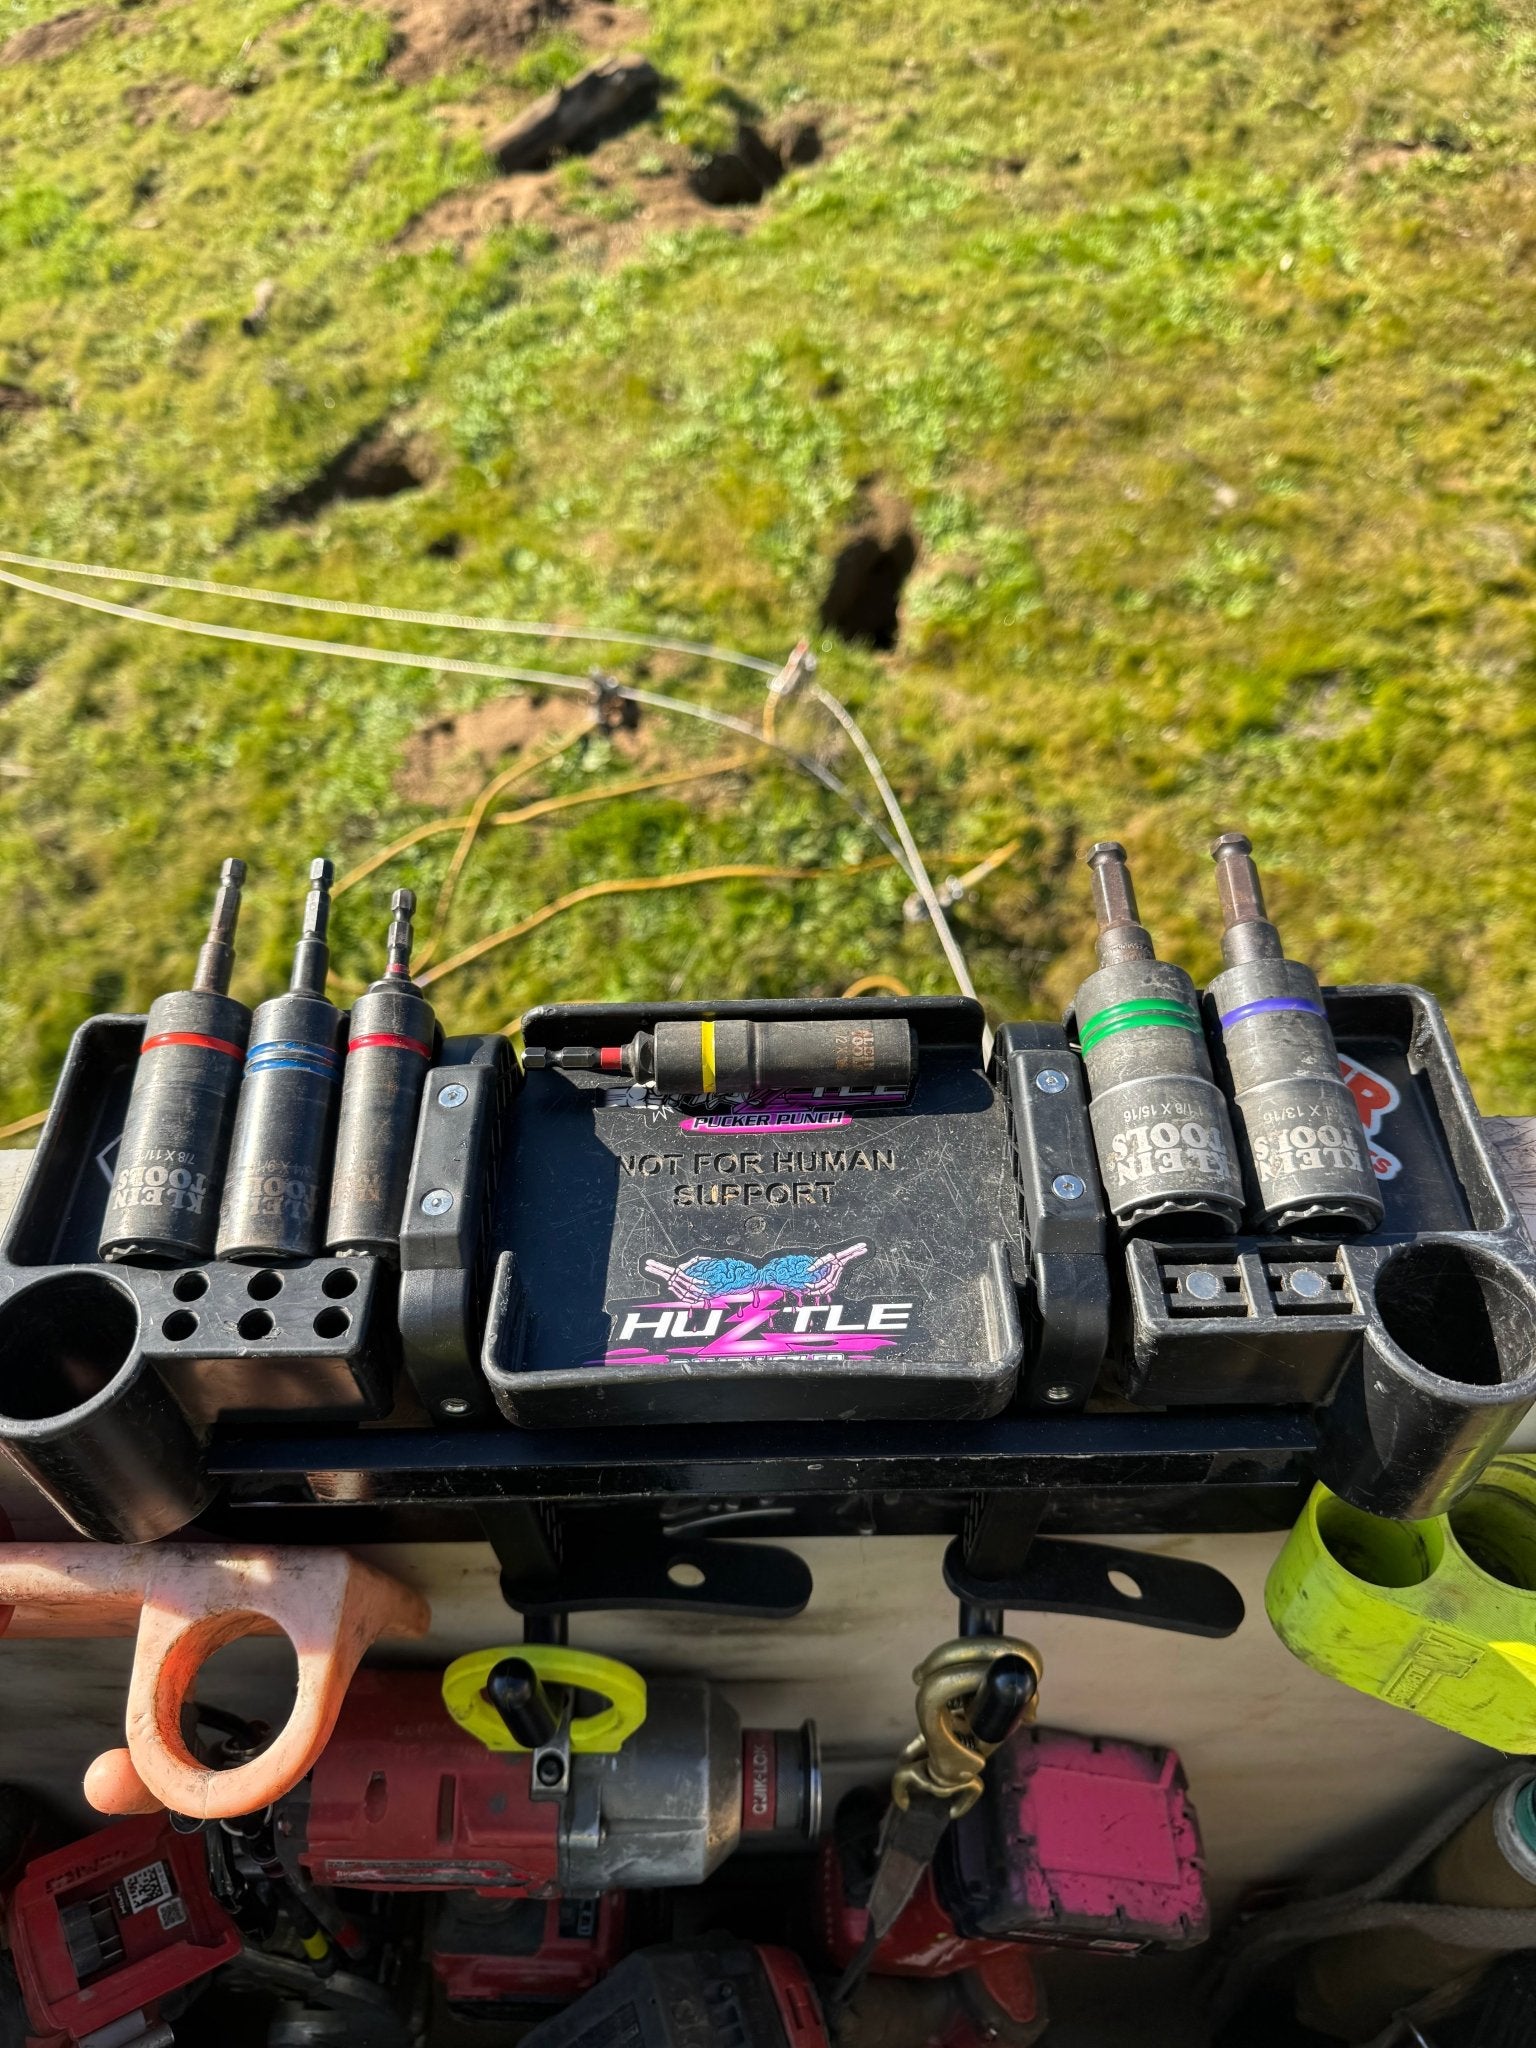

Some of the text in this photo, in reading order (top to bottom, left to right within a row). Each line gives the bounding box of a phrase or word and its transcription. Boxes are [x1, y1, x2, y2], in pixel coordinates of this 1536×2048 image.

[693, 1110, 845, 1129] PUCKER PUNCH
[1123, 1104, 1158, 1122] 15/16
[1161, 1102, 1171, 1115] X
[1309, 1104, 1320, 1117] X
[165, 1149, 176, 1161] X
[1112, 1122, 1227, 1161] TOOLS
[1254, 1125, 1359, 1161] TOOLS
[615, 1149, 896, 1177] NOT FOR HUMAN
[1117, 1148, 1232, 1186] KLEIN
[1258, 1148, 1363, 1183] KLEIN
[117, 1165, 207, 1196] TOOLS
[673, 1181, 836, 1207] SUPPORT
[111, 1186, 205, 1214] KLEIN
